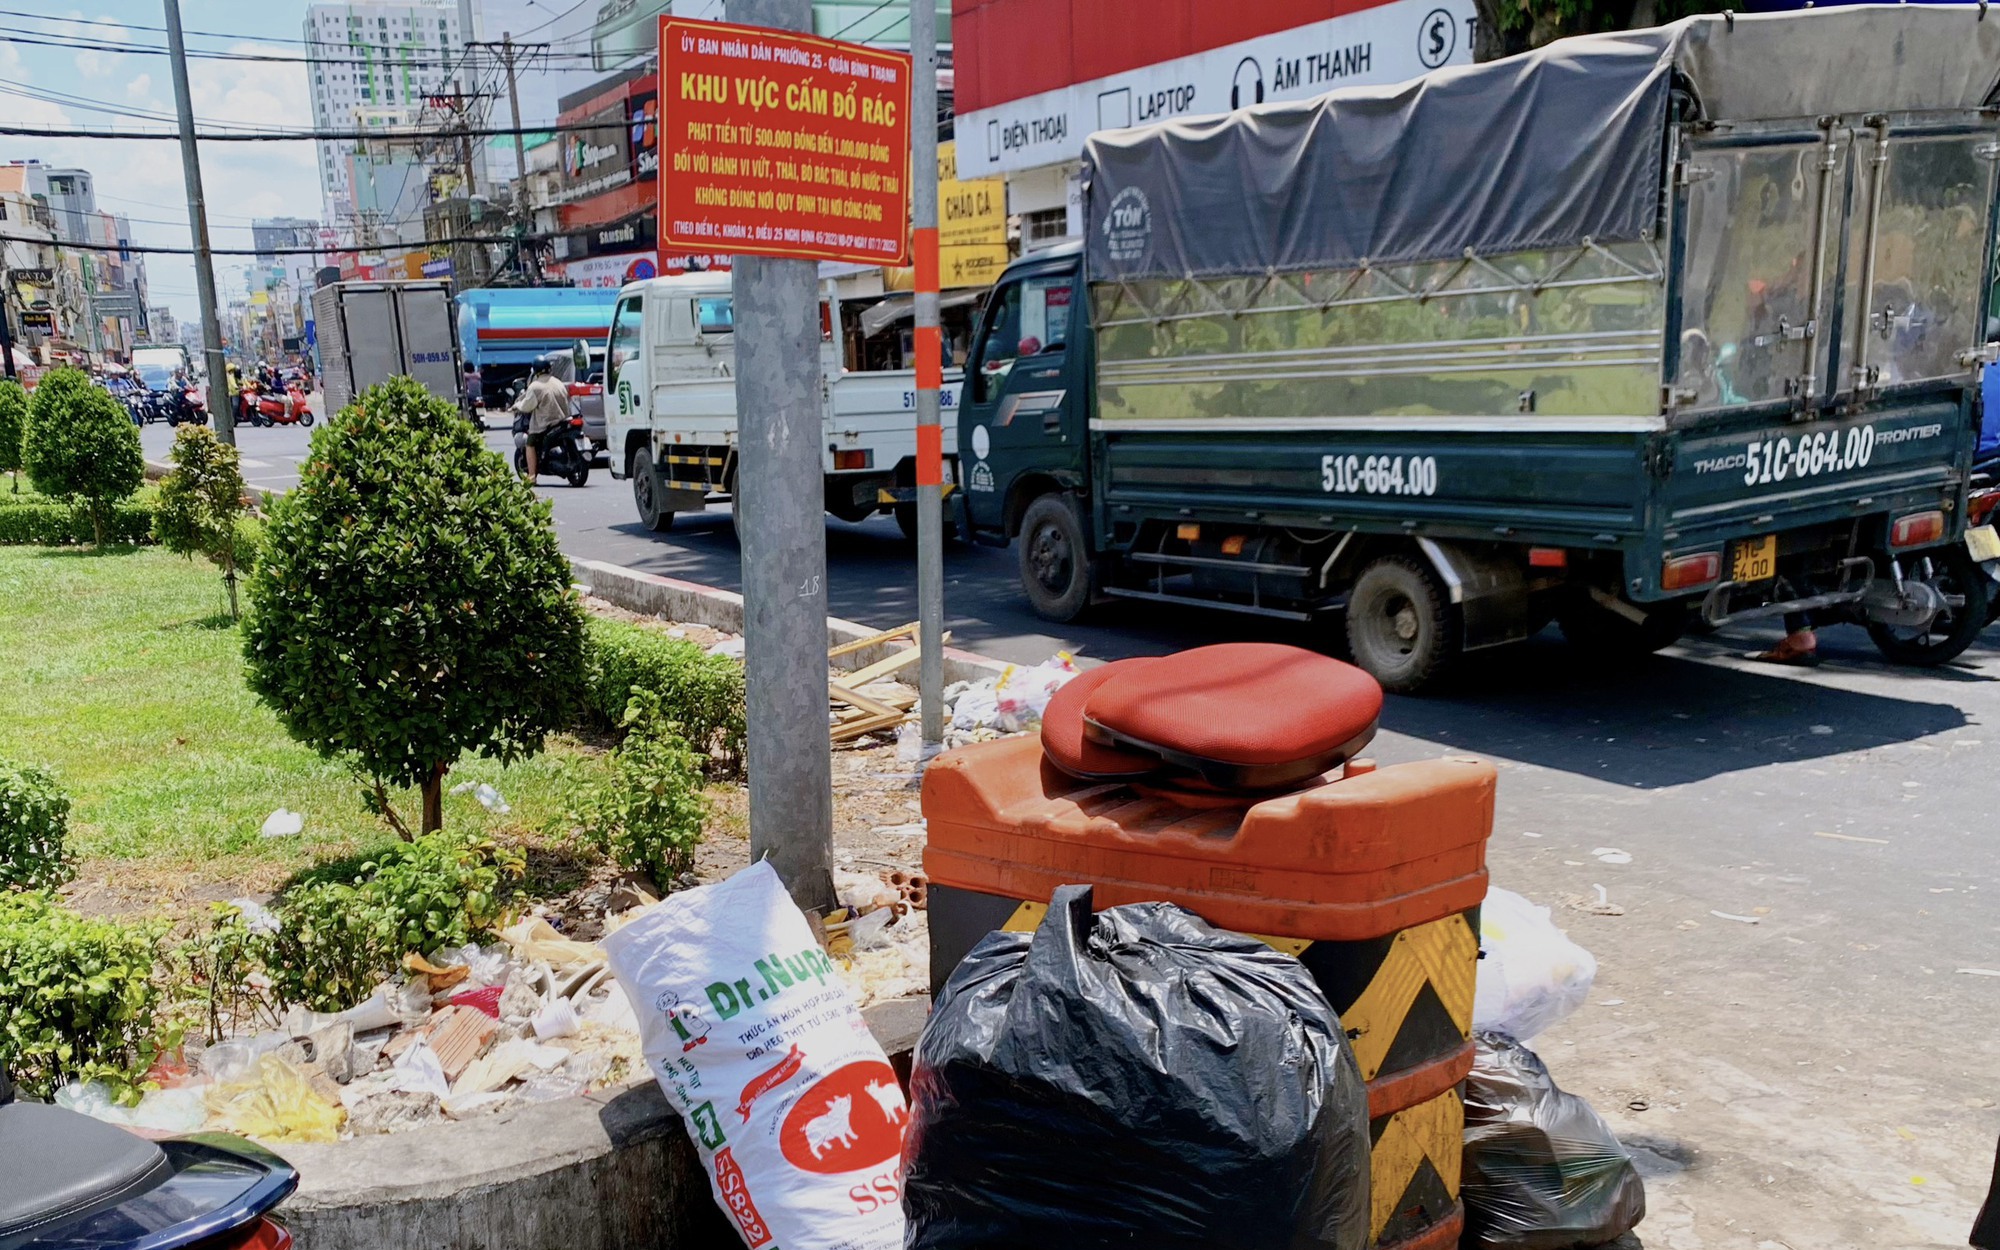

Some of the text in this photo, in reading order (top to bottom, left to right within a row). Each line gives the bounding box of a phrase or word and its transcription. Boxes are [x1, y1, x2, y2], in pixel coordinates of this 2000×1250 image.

[697, 38, 719, 56] BAN
[721, 39, 748, 59] NHÂN
[750, 41, 772, 62] DÂN
[811, 54, 822, 69] 25
[1273, 42, 1372, 92] ÂM THANH
[681, 72, 896, 127] KHU VỰC CẤM ĐỔ RÁC
[1138, 85, 1196, 121] LAPTOP
[687, 121, 713, 145] PHẠT
[1003, 113, 1068, 153] ĐIỆN THOẠI
[740, 159, 750, 176] VI
[695, 182, 728, 206] KHÔNG
[775, 192, 794, 213] QUY
[599, 226, 635, 245] SAMSUNG
[1693, 423, 1942, 486] THACO 51C-664.00 FRONTIER
[1321, 455, 1437, 496] 51C-664.00
[800, 575, 820, 596] 18
[763, 1034, 784, 1052] HEO
[717, 1154, 765, 1244] SS822
